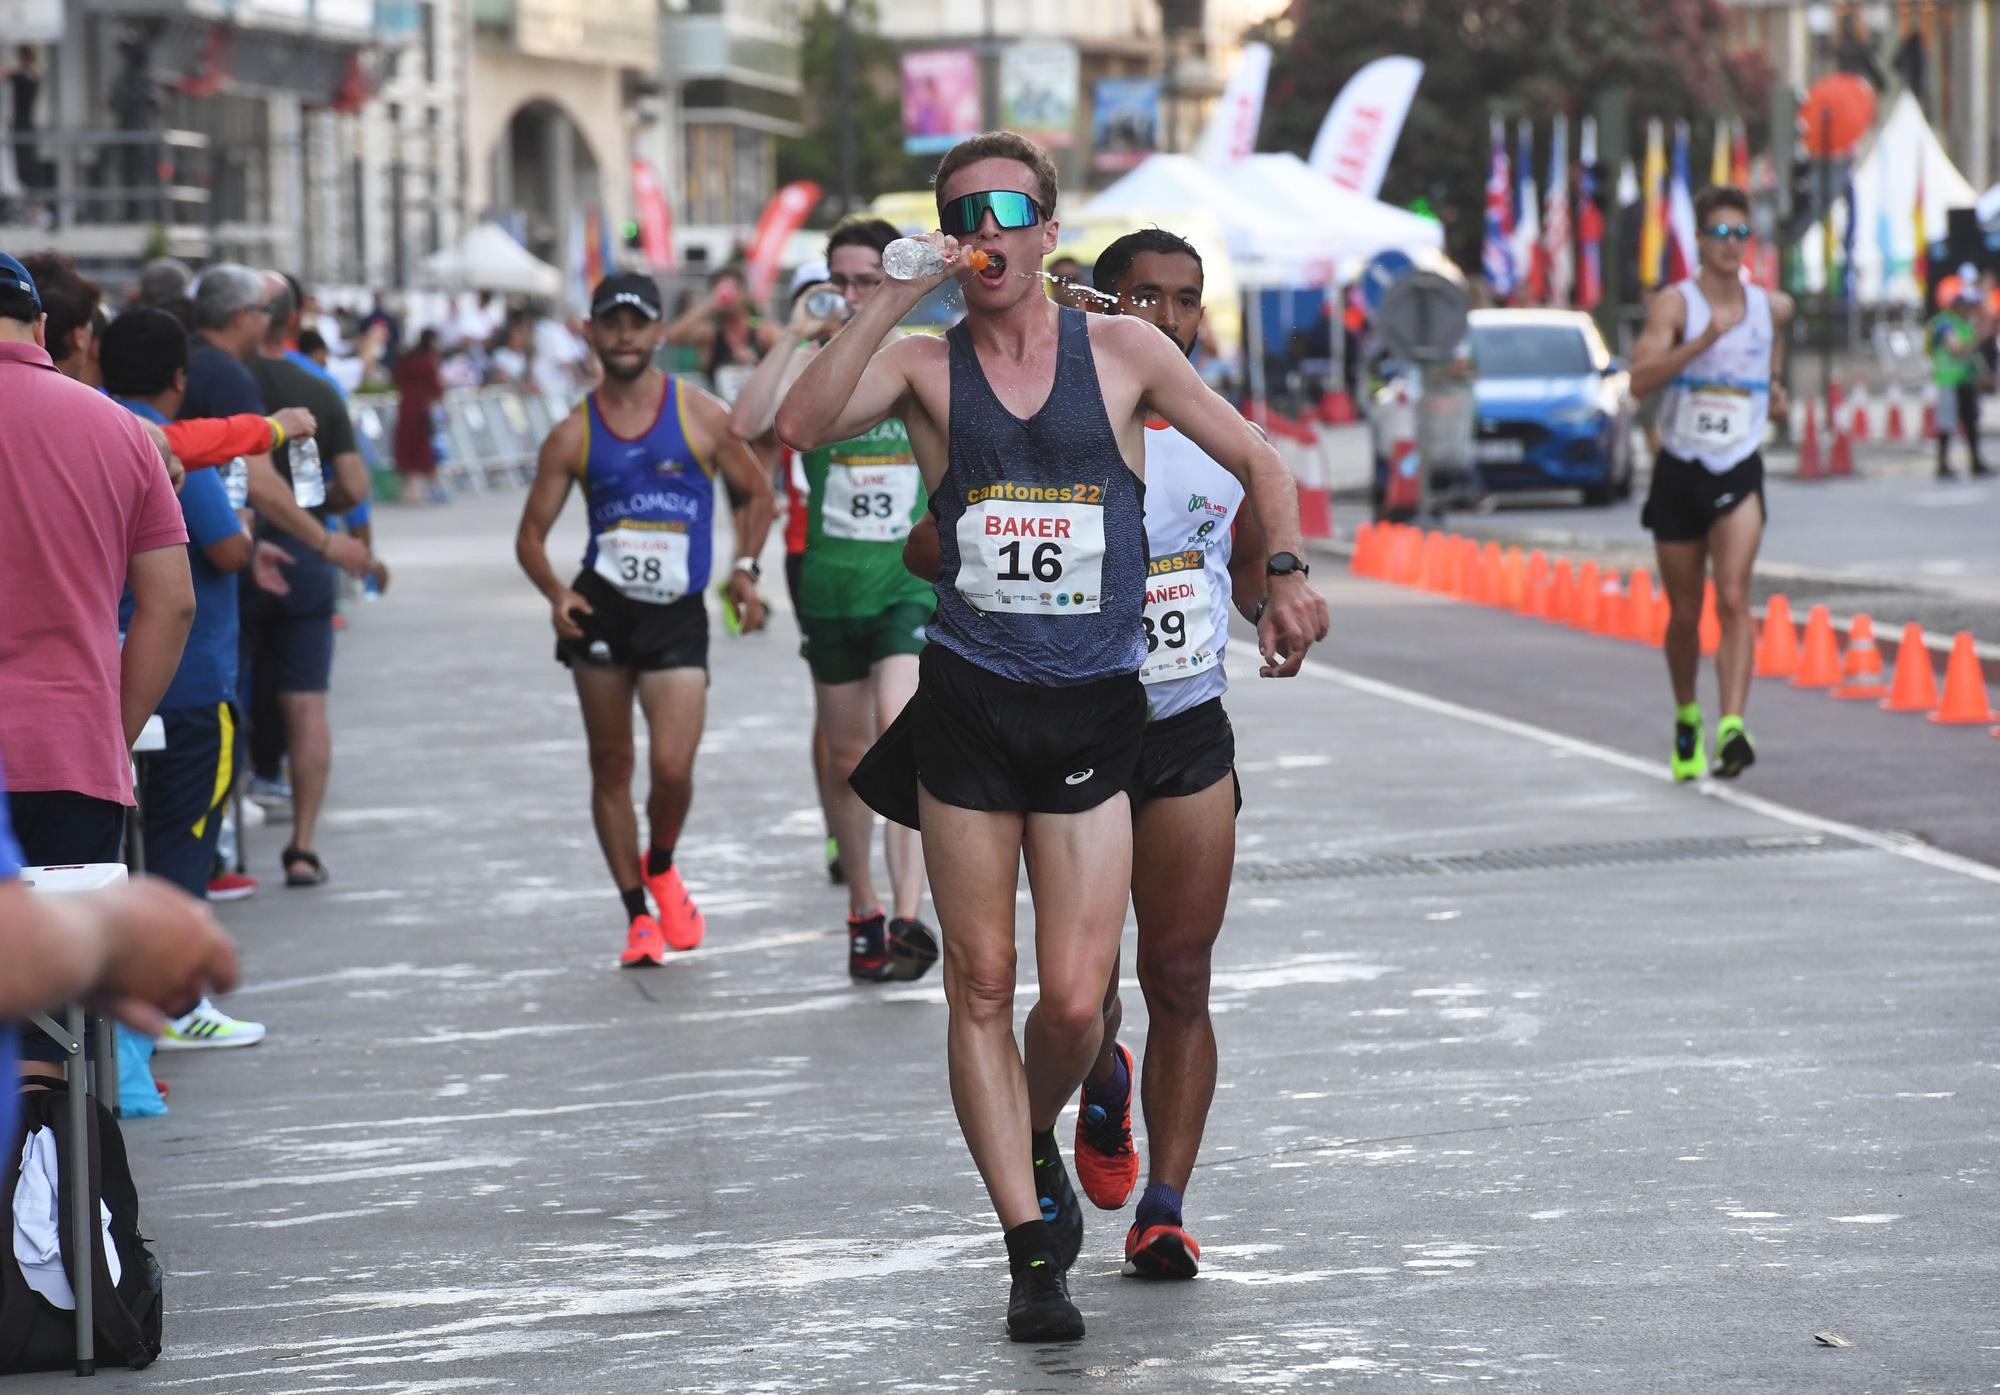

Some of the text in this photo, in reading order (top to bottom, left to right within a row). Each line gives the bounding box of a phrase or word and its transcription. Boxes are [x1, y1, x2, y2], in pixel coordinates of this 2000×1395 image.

[1698, 414, 1728, 434] 54
[968, 482, 1101, 503] cantones22
[595, 492, 698, 520] COLOMBIA
[850, 494, 892, 518] 83
[985, 515, 1071, 538] BAKER
[621, 556, 661, 582] 38
[997, 540, 1063, 583] 16
